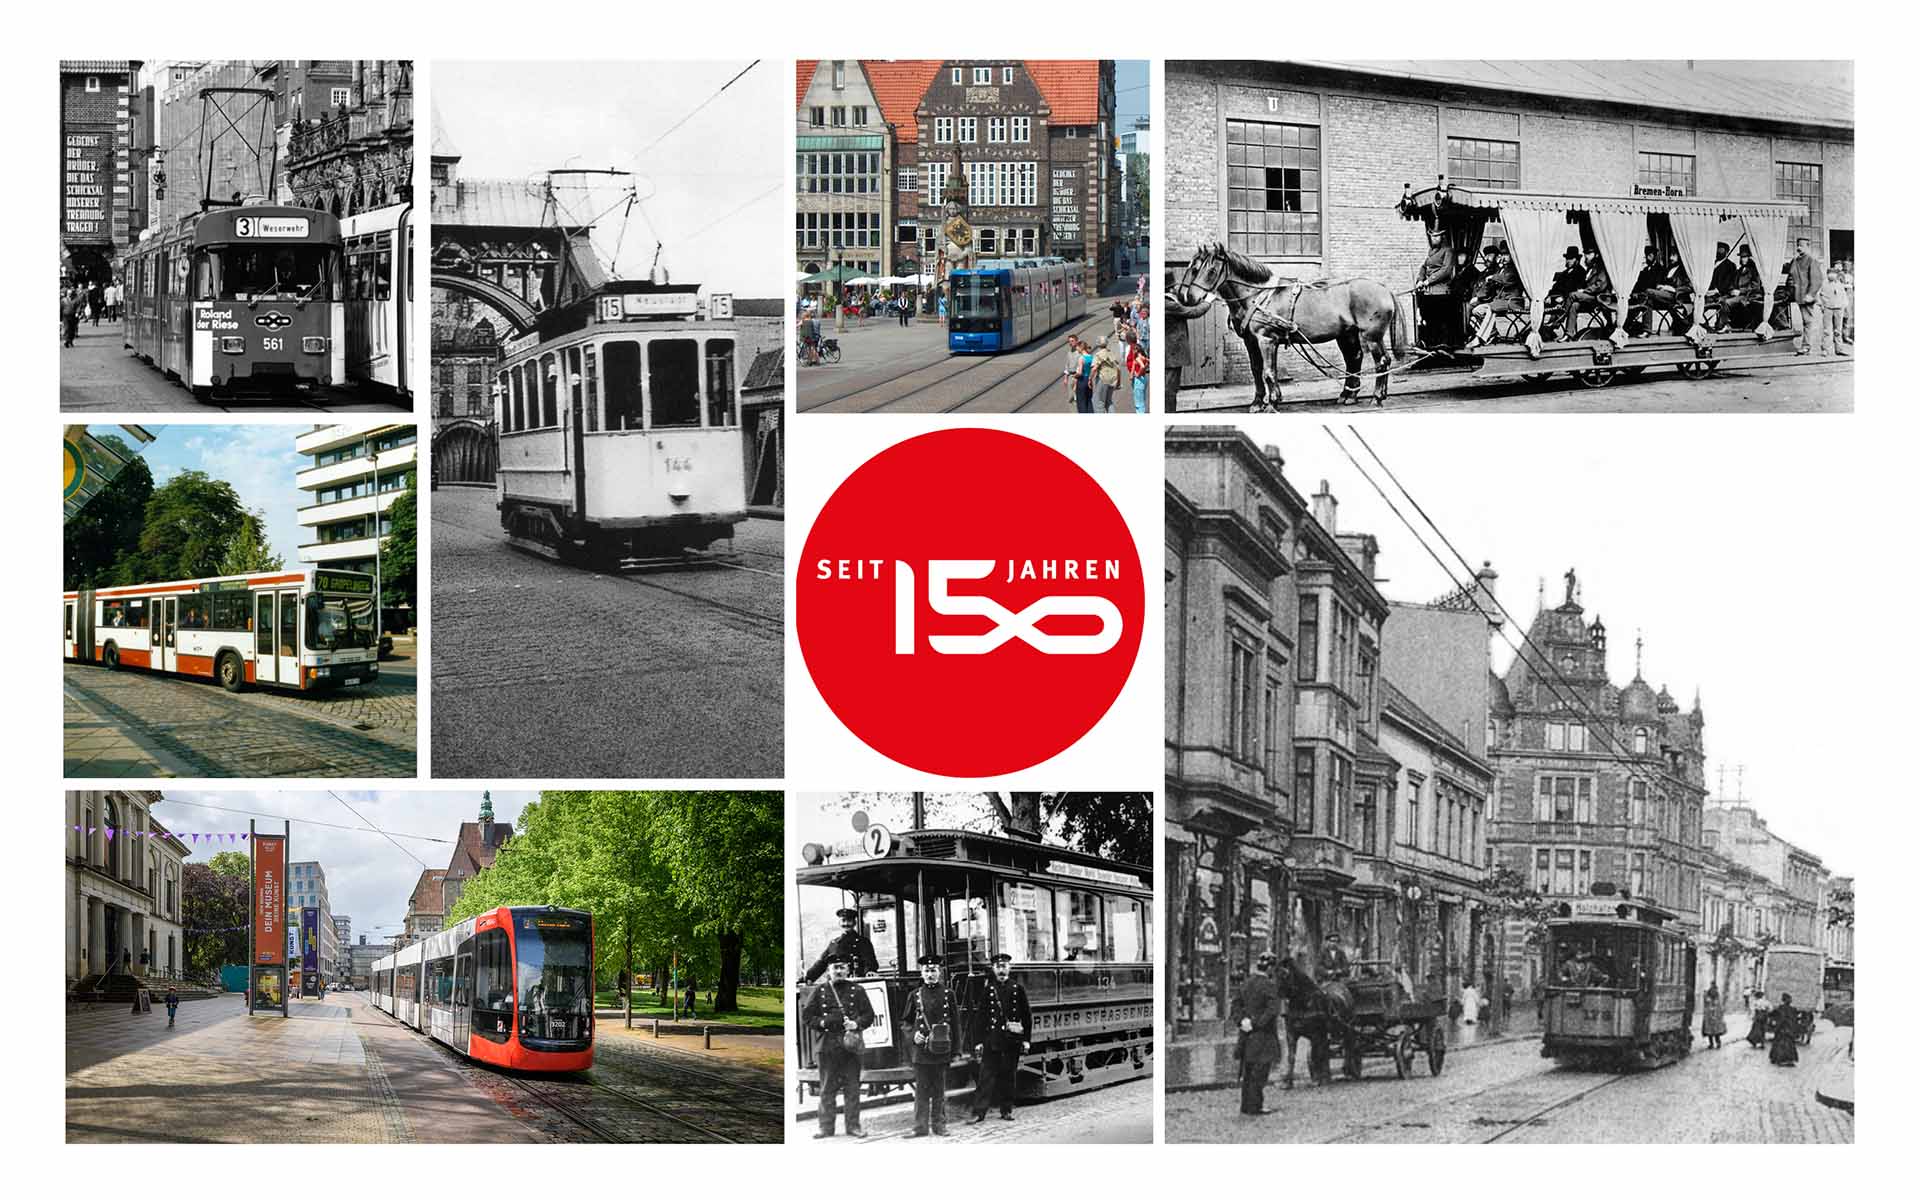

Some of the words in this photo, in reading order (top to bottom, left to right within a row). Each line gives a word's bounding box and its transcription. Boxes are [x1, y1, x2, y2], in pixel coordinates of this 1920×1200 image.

[1634, 184, 1683, 197] Bremen-Horn
[239, 218, 250, 236] 3
[263, 223, 304, 233] Weserwehr
[200, 308, 232, 319] Roland
[604, 299, 620, 317] 15
[196, 320, 210, 329] der
[211, 320, 239, 330] Riese
[263, 337, 283, 351] 561
[871, 829, 885, 855] 2
[264, 870, 273, 909] MUSEUM
[264, 911, 273, 933] DEIN
